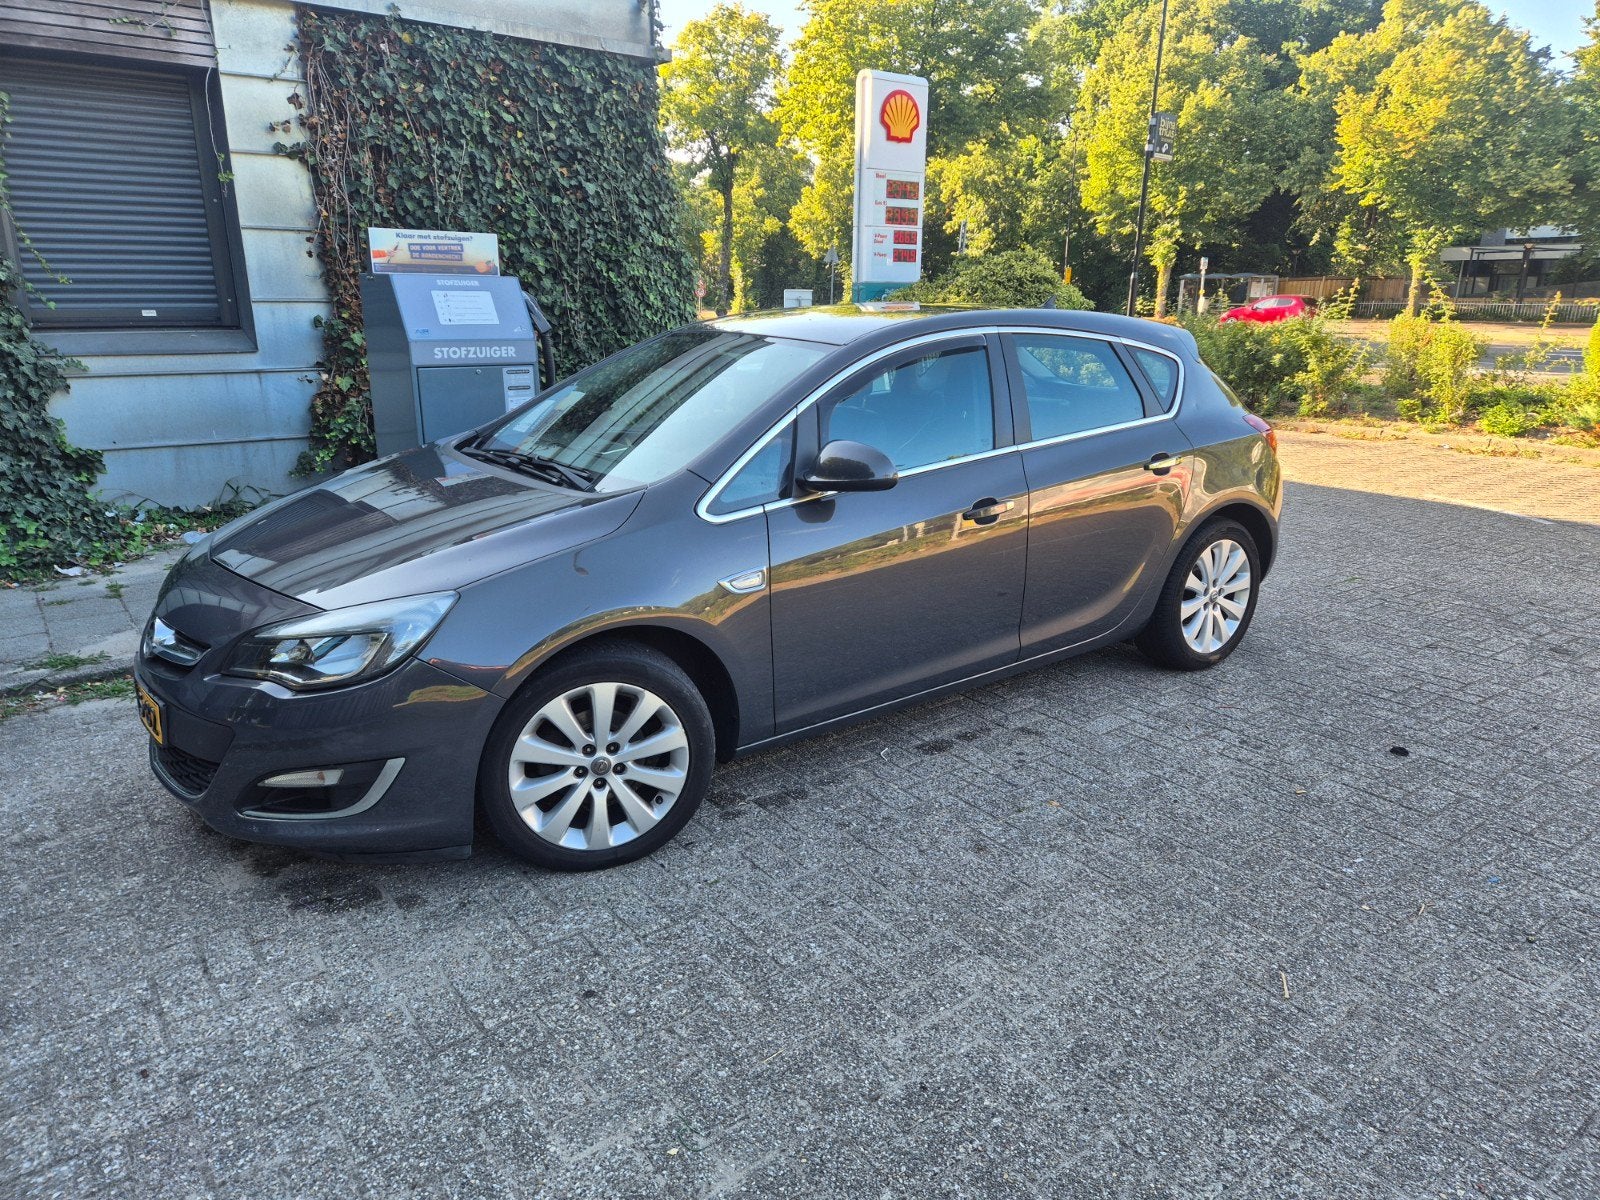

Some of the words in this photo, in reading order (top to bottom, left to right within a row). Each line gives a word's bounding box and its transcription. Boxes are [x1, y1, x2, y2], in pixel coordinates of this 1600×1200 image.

[395, 232, 416, 240] Klaar
[433, 234, 473, 243] stofzuigen?
[436, 279, 480, 287] STOFZUIGER
[433, 346, 516, 359] STOFZUIGER
